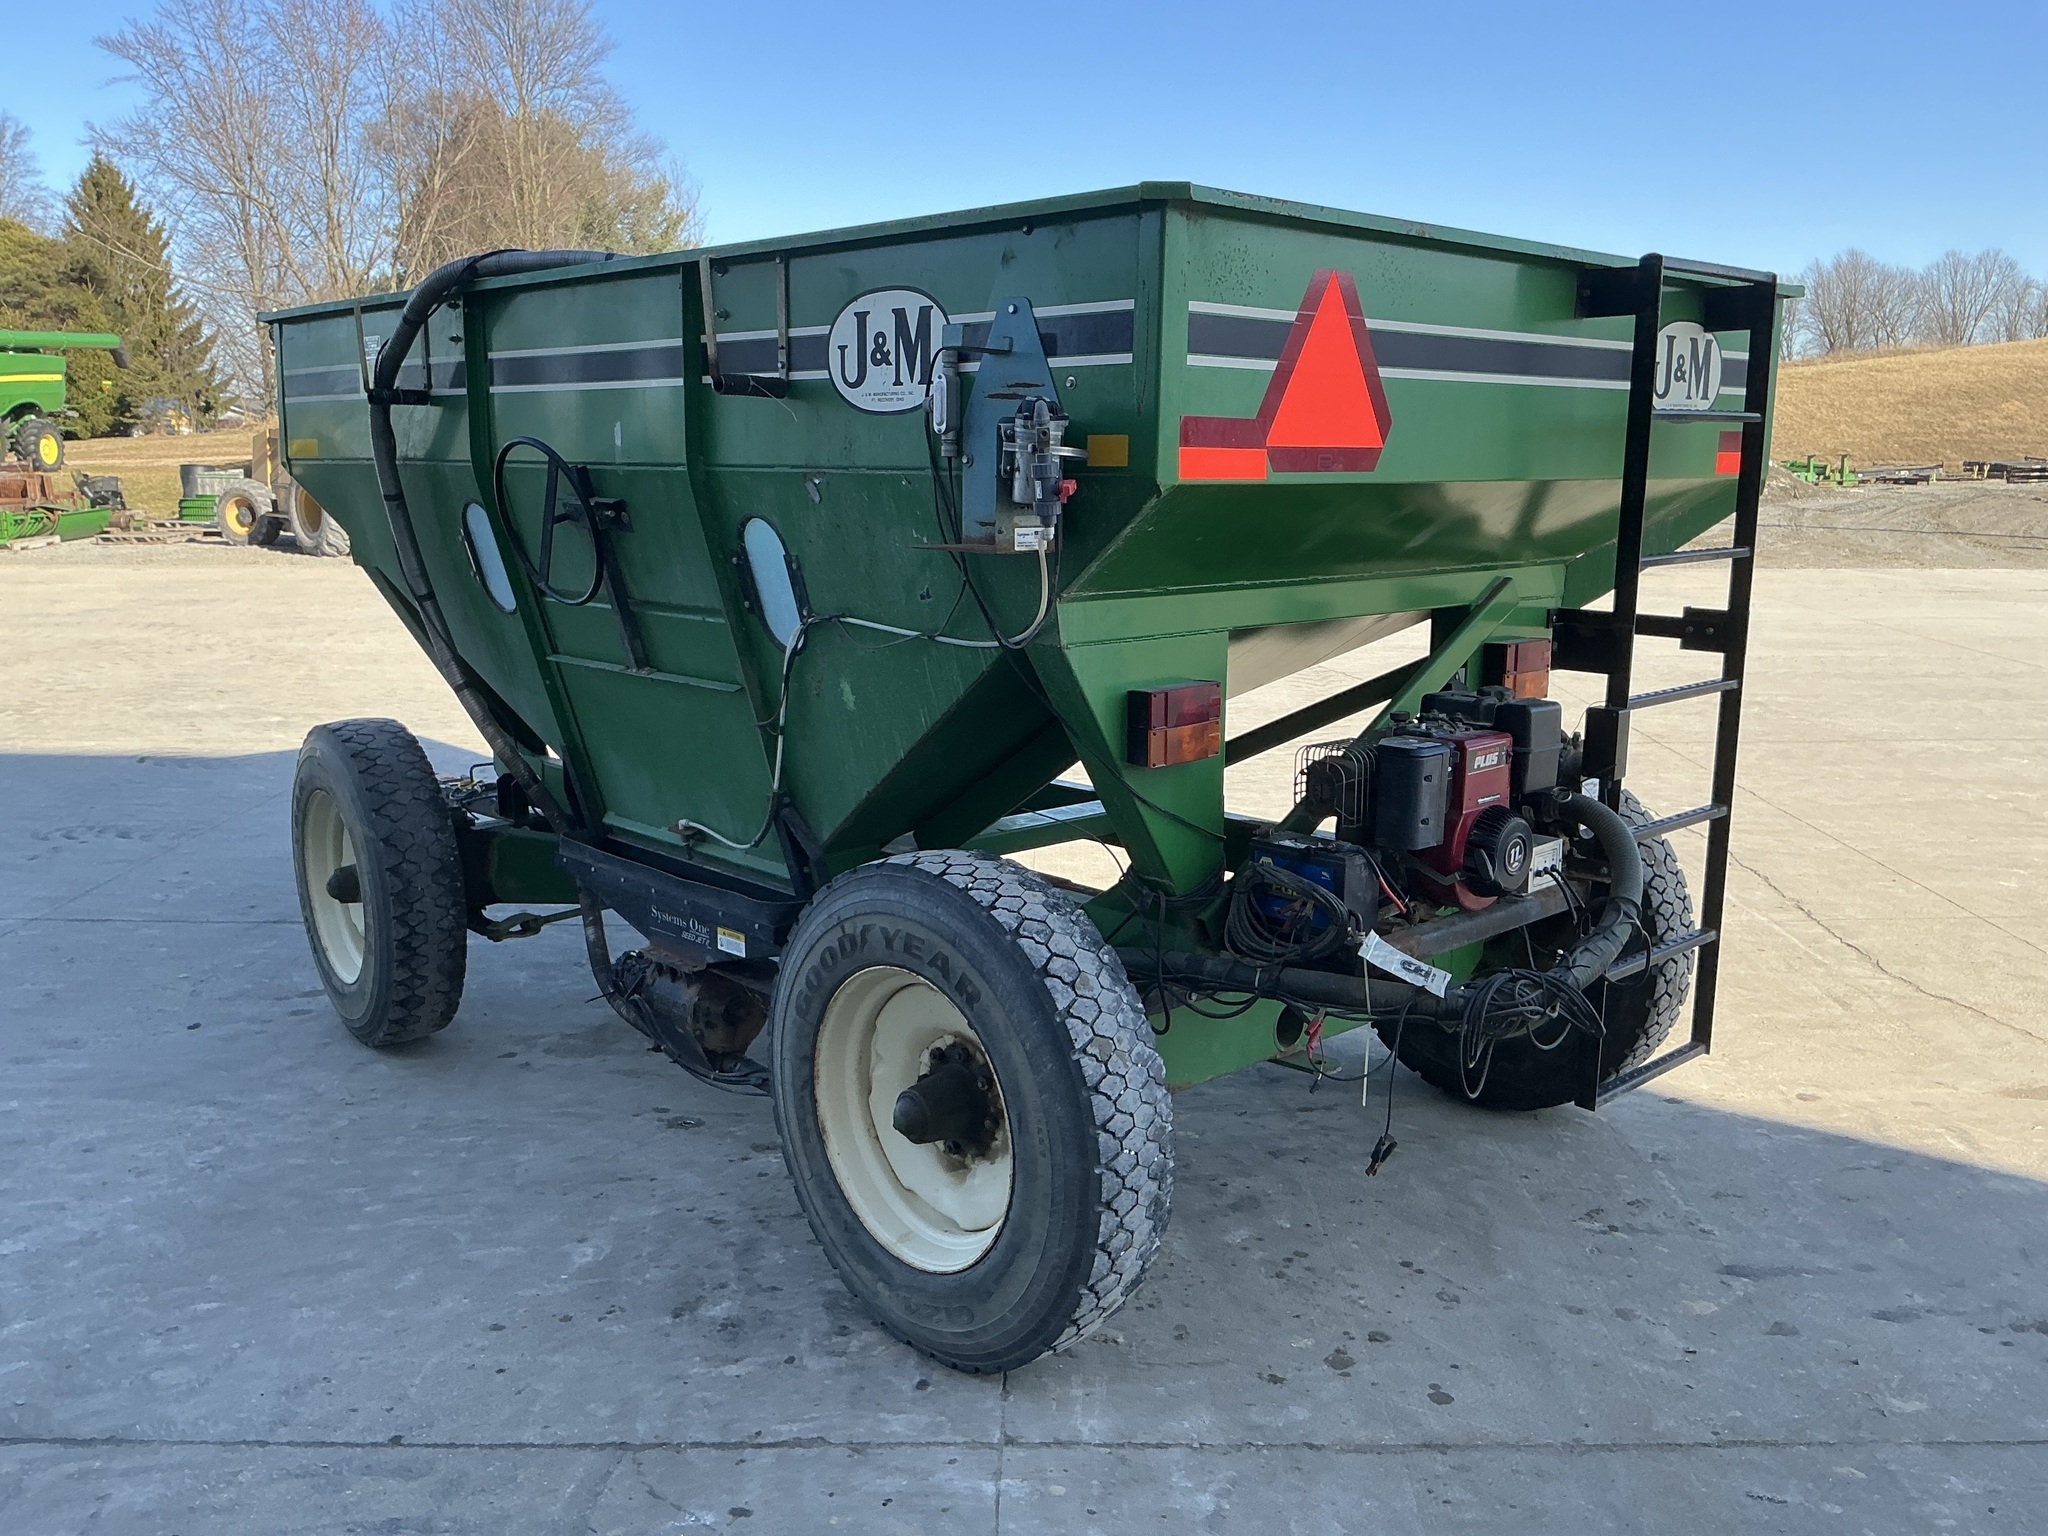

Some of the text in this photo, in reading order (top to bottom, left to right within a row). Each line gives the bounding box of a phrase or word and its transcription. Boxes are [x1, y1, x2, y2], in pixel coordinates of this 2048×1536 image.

[837, 305, 934, 390] J&M
[1654, 335, 1713, 400] J&M
[1474, 752, 1499, 769] PLUS
[651, 904, 710, 934] Systems One
[681, 931, 696, 942] SEED
[695, 936, 706, 945] JET
[795, 923, 982, 1020] GOODYEAR
